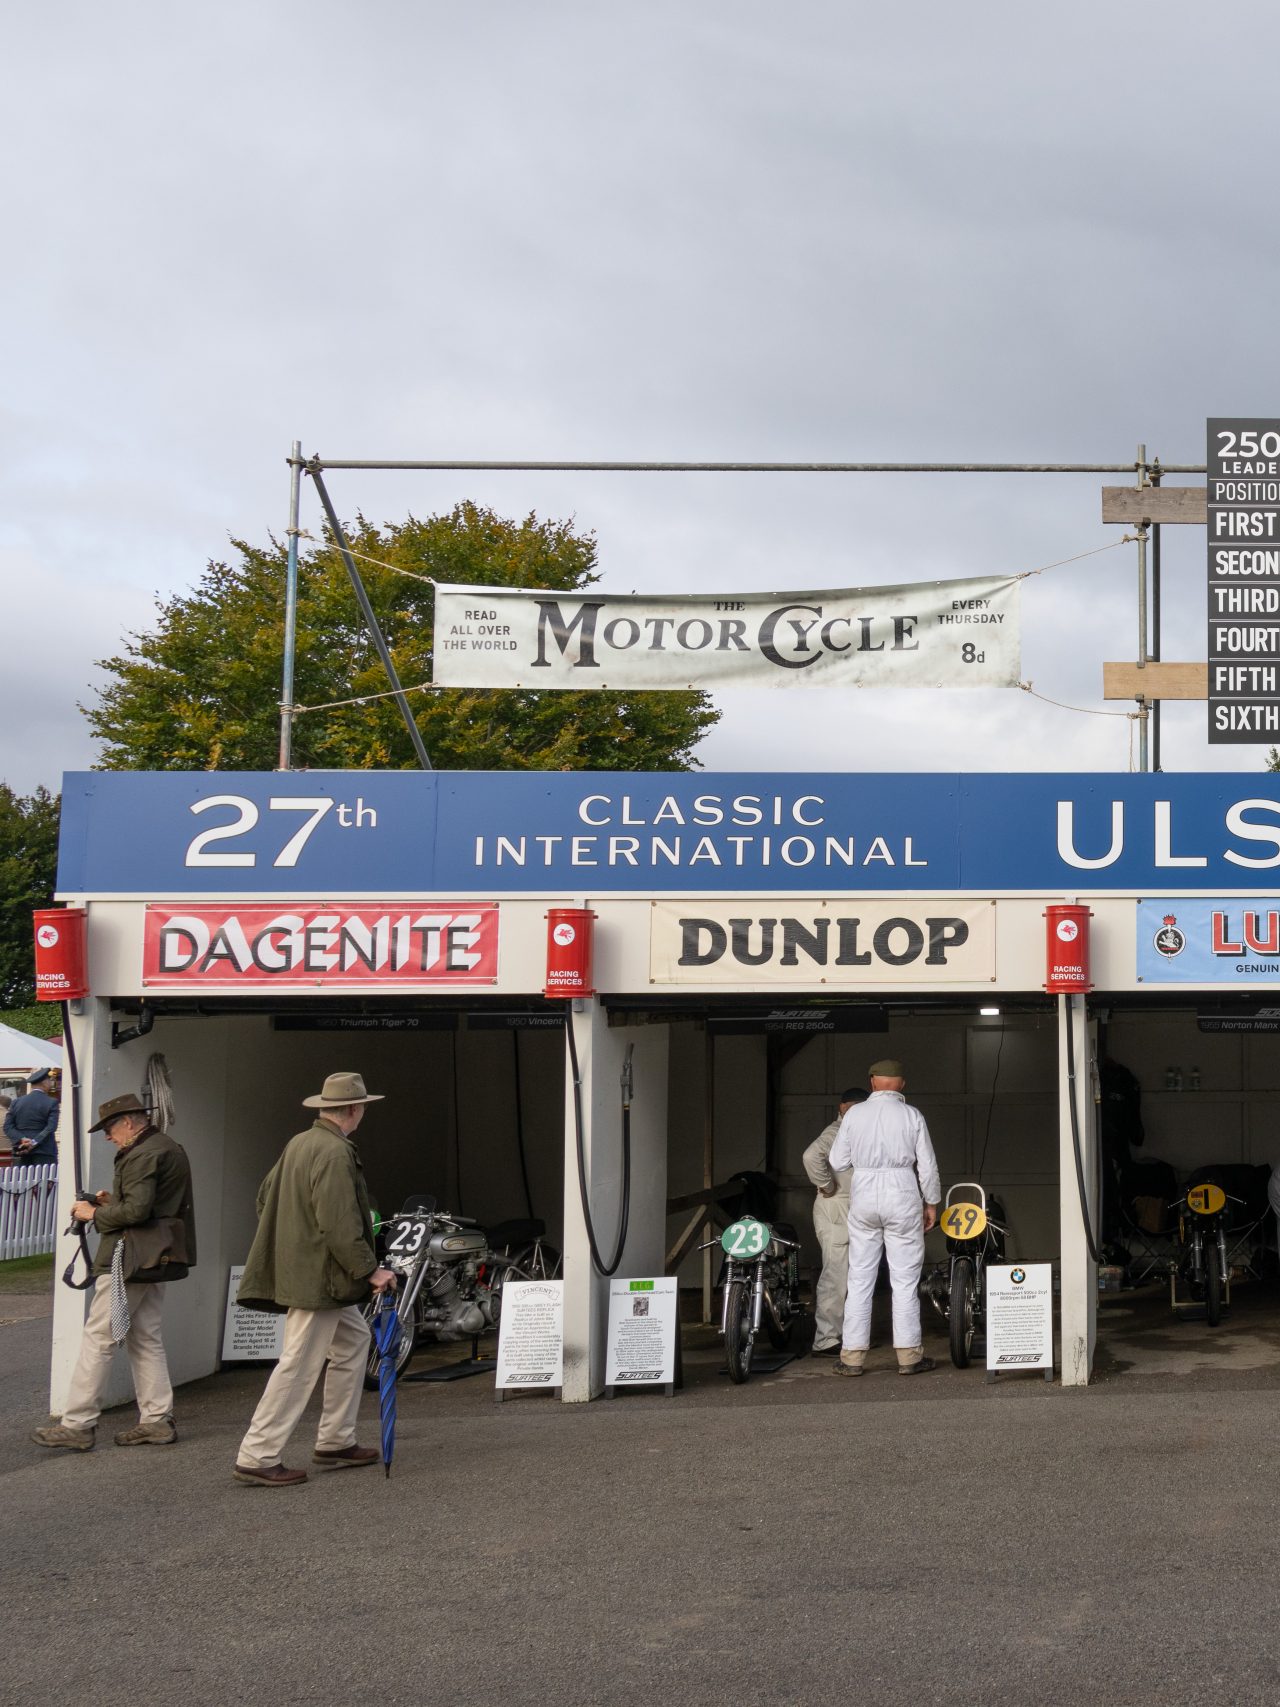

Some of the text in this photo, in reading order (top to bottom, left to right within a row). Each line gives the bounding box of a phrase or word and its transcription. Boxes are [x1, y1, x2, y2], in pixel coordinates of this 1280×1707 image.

[1216, 512, 1277, 536] FIRST
[714, 601, 745, 611] THE
[952, 599, 991, 611] EVERY
[1215, 588, 1279, 613] THIRD
[464, 610, 497, 621] READ
[937, 613, 1005, 626] THURSDAY
[450, 625, 511, 636] ALL OVER
[443, 640, 518, 651] THE WORLD
[961, 642, 986, 665] 8d
[1215, 667, 1276, 691] FIFTH
[1215, 705, 1279, 731] SIXTH
[578, 795, 826, 827] CLASSIC
[185, 794, 377, 868] 27th
[475, 836, 929, 867] INTERNATIONAL
[159, 915, 483, 973] DAGENITE
[678, 917, 970, 966] DUNLOP
[550, 970, 579, 978] RACING
[1054, 966, 1082, 974] RACING
[548, 978, 582, 986] SERVICES
[1051, 973, 1085, 981] SERVICES
[339, 1016, 378, 1027] Triumph
[381, 1017, 405, 1028] Tiger
[407, 1017, 419, 1026] 70
[528, 1016, 563, 1025] Vincent
[786, 1022, 804, 1030] REG
[947, 1209, 978, 1237] 49
[388, 1221, 427, 1251] 23
[730, 1223, 764, 1254] 23
[522, 1286, 552, 1294] VINCENT
